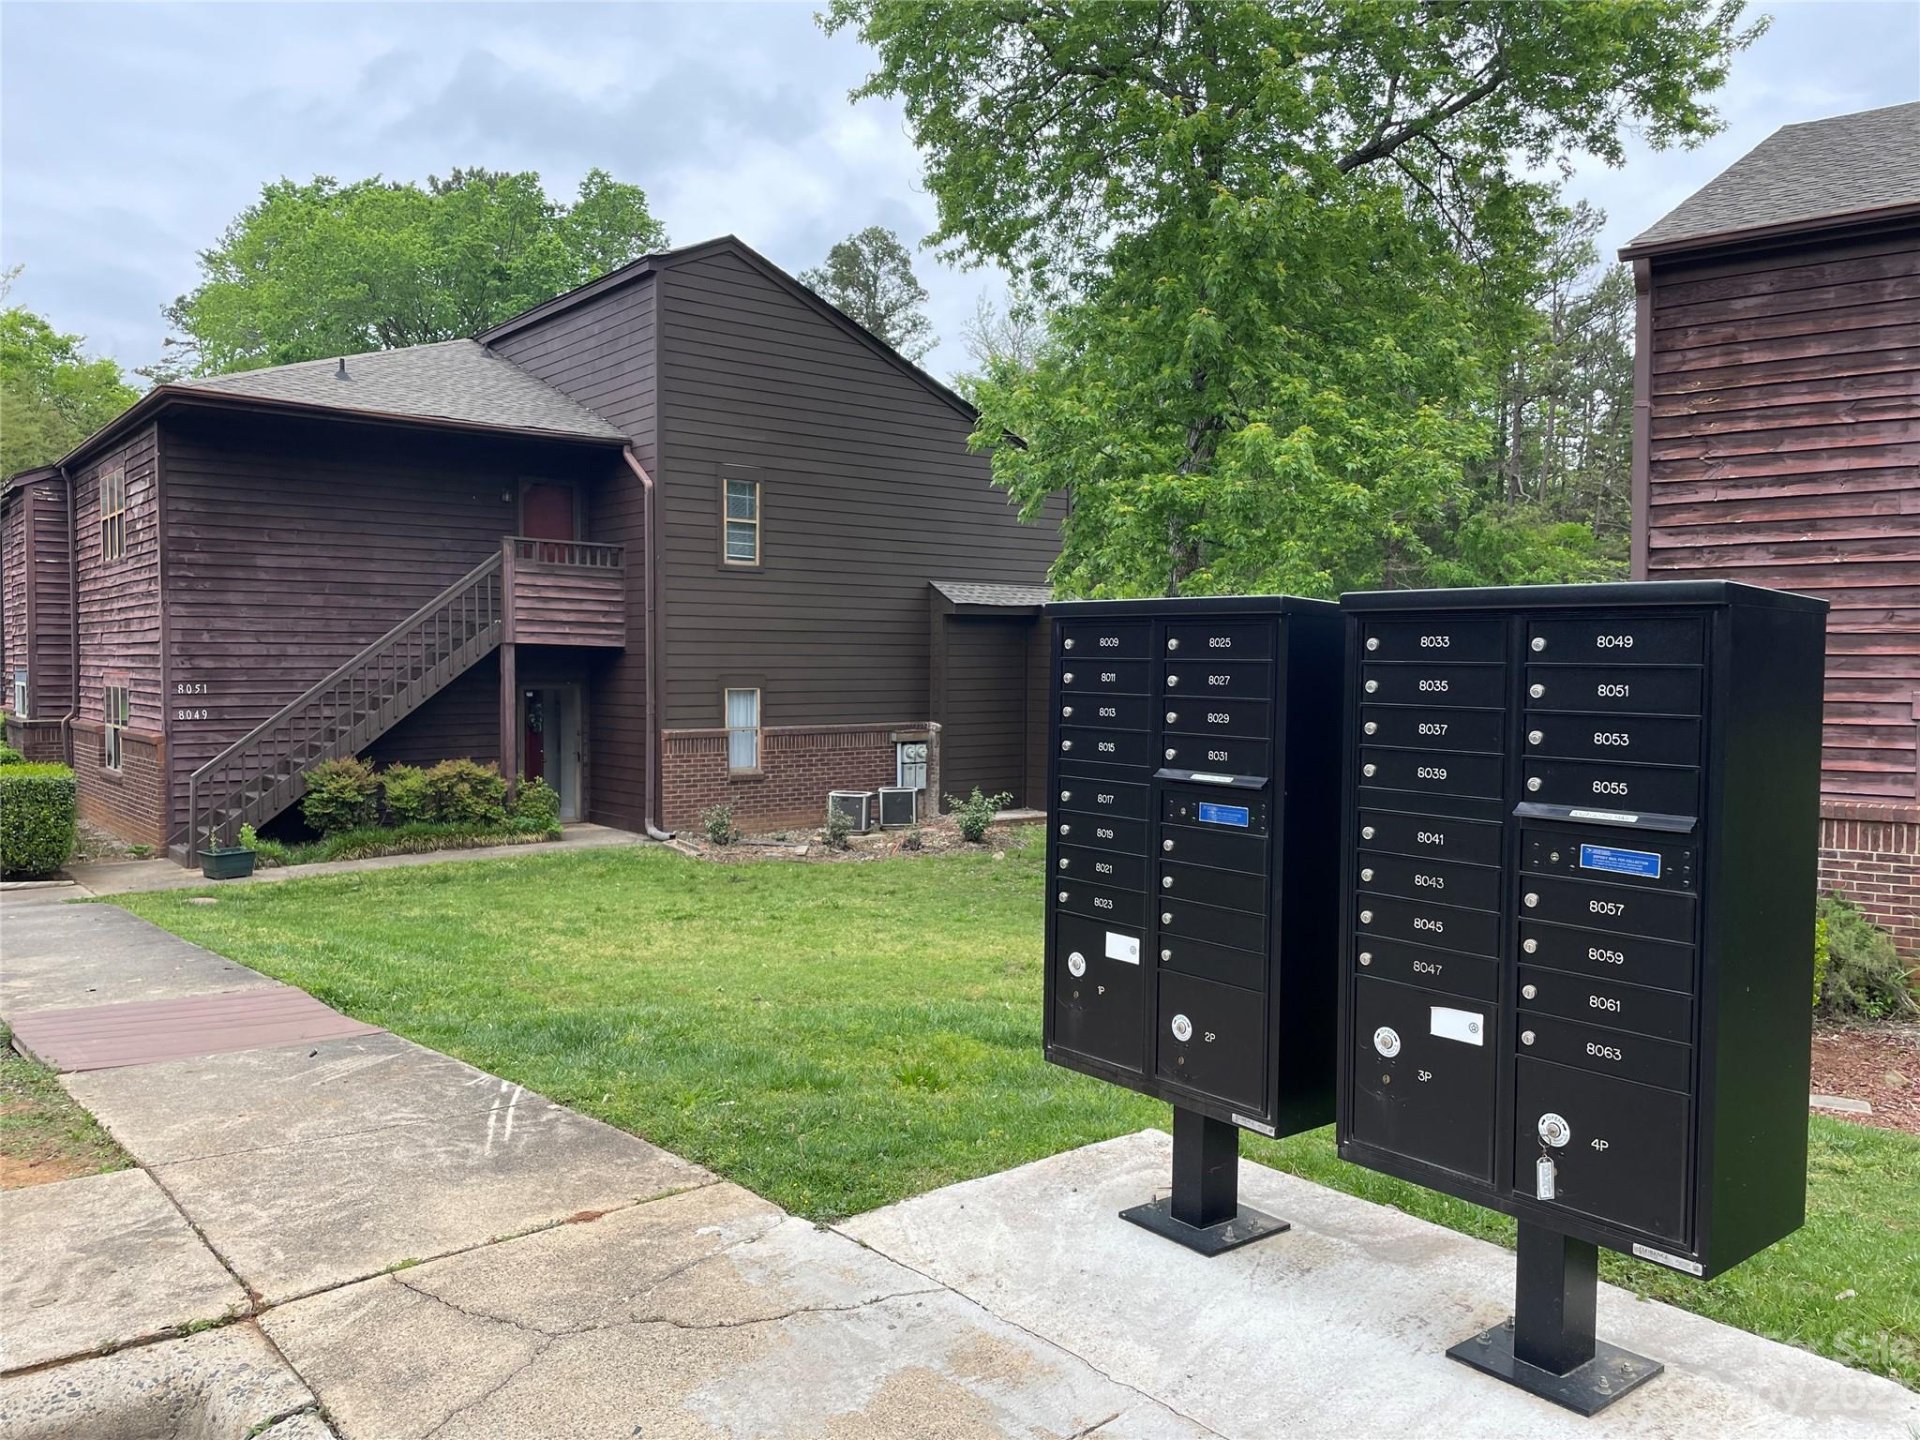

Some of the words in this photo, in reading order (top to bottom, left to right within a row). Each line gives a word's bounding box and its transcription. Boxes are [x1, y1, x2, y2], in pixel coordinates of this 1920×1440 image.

[1099, 637, 1120, 647] 8009
[1208, 637, 1232, 648] 8025
[1420, 635, 1450, 648] 8033
[1596, 635, 1634, 648] 8049
[1100, 672, 1116, 682] 8011
[1208, 675, 1231, 686] 8027
[177, 683, 208, 695] 8051
[1418, 679, 1449, 692] 8035
[1597, 683, 1629, 698] 8051
[177, 708, 208, 721] 8049
[1098, 707, 1117, 717] 8013
[1207, 712, 1230, 724] 8029
[1418, 723, 1448, 736] 8037
[1593, 732, 1630, 746] 8053
[1098, 741, 1116, 752] 8015
[1207, 750, 1228, 762] 8031
[1417, 766, 1447, 780] 8039
[1592, 780, 1628, 796] 8055
[1097, 793, 1115, 804] 8017
[1096, 828, 1114, 839] 8019
[1417, 831, 1444, 846] 8041
[1095, 862, 1113, 874] 8021
[1414, 874, 1445, 889] 8043
[1094, 897, 1113, 910] 8023
[1589, 900, 1625, 916] 8057
[1413, 917, 1444, 933] 8045
[1588, 947, 1624, 965] 8059
[1413, 960, 1443, 976] 8047
[1097, 985, 1105, 995] 1P
[1589, 995, 1621, 1013] 8061
[1204, 1031, 1216, 1043] 2P
[1586, 1042, 1622, 1061] 8063
[1417, 1069, 1433, 1083] 3P
[1590, 1138, 1609, 1152] 4P
